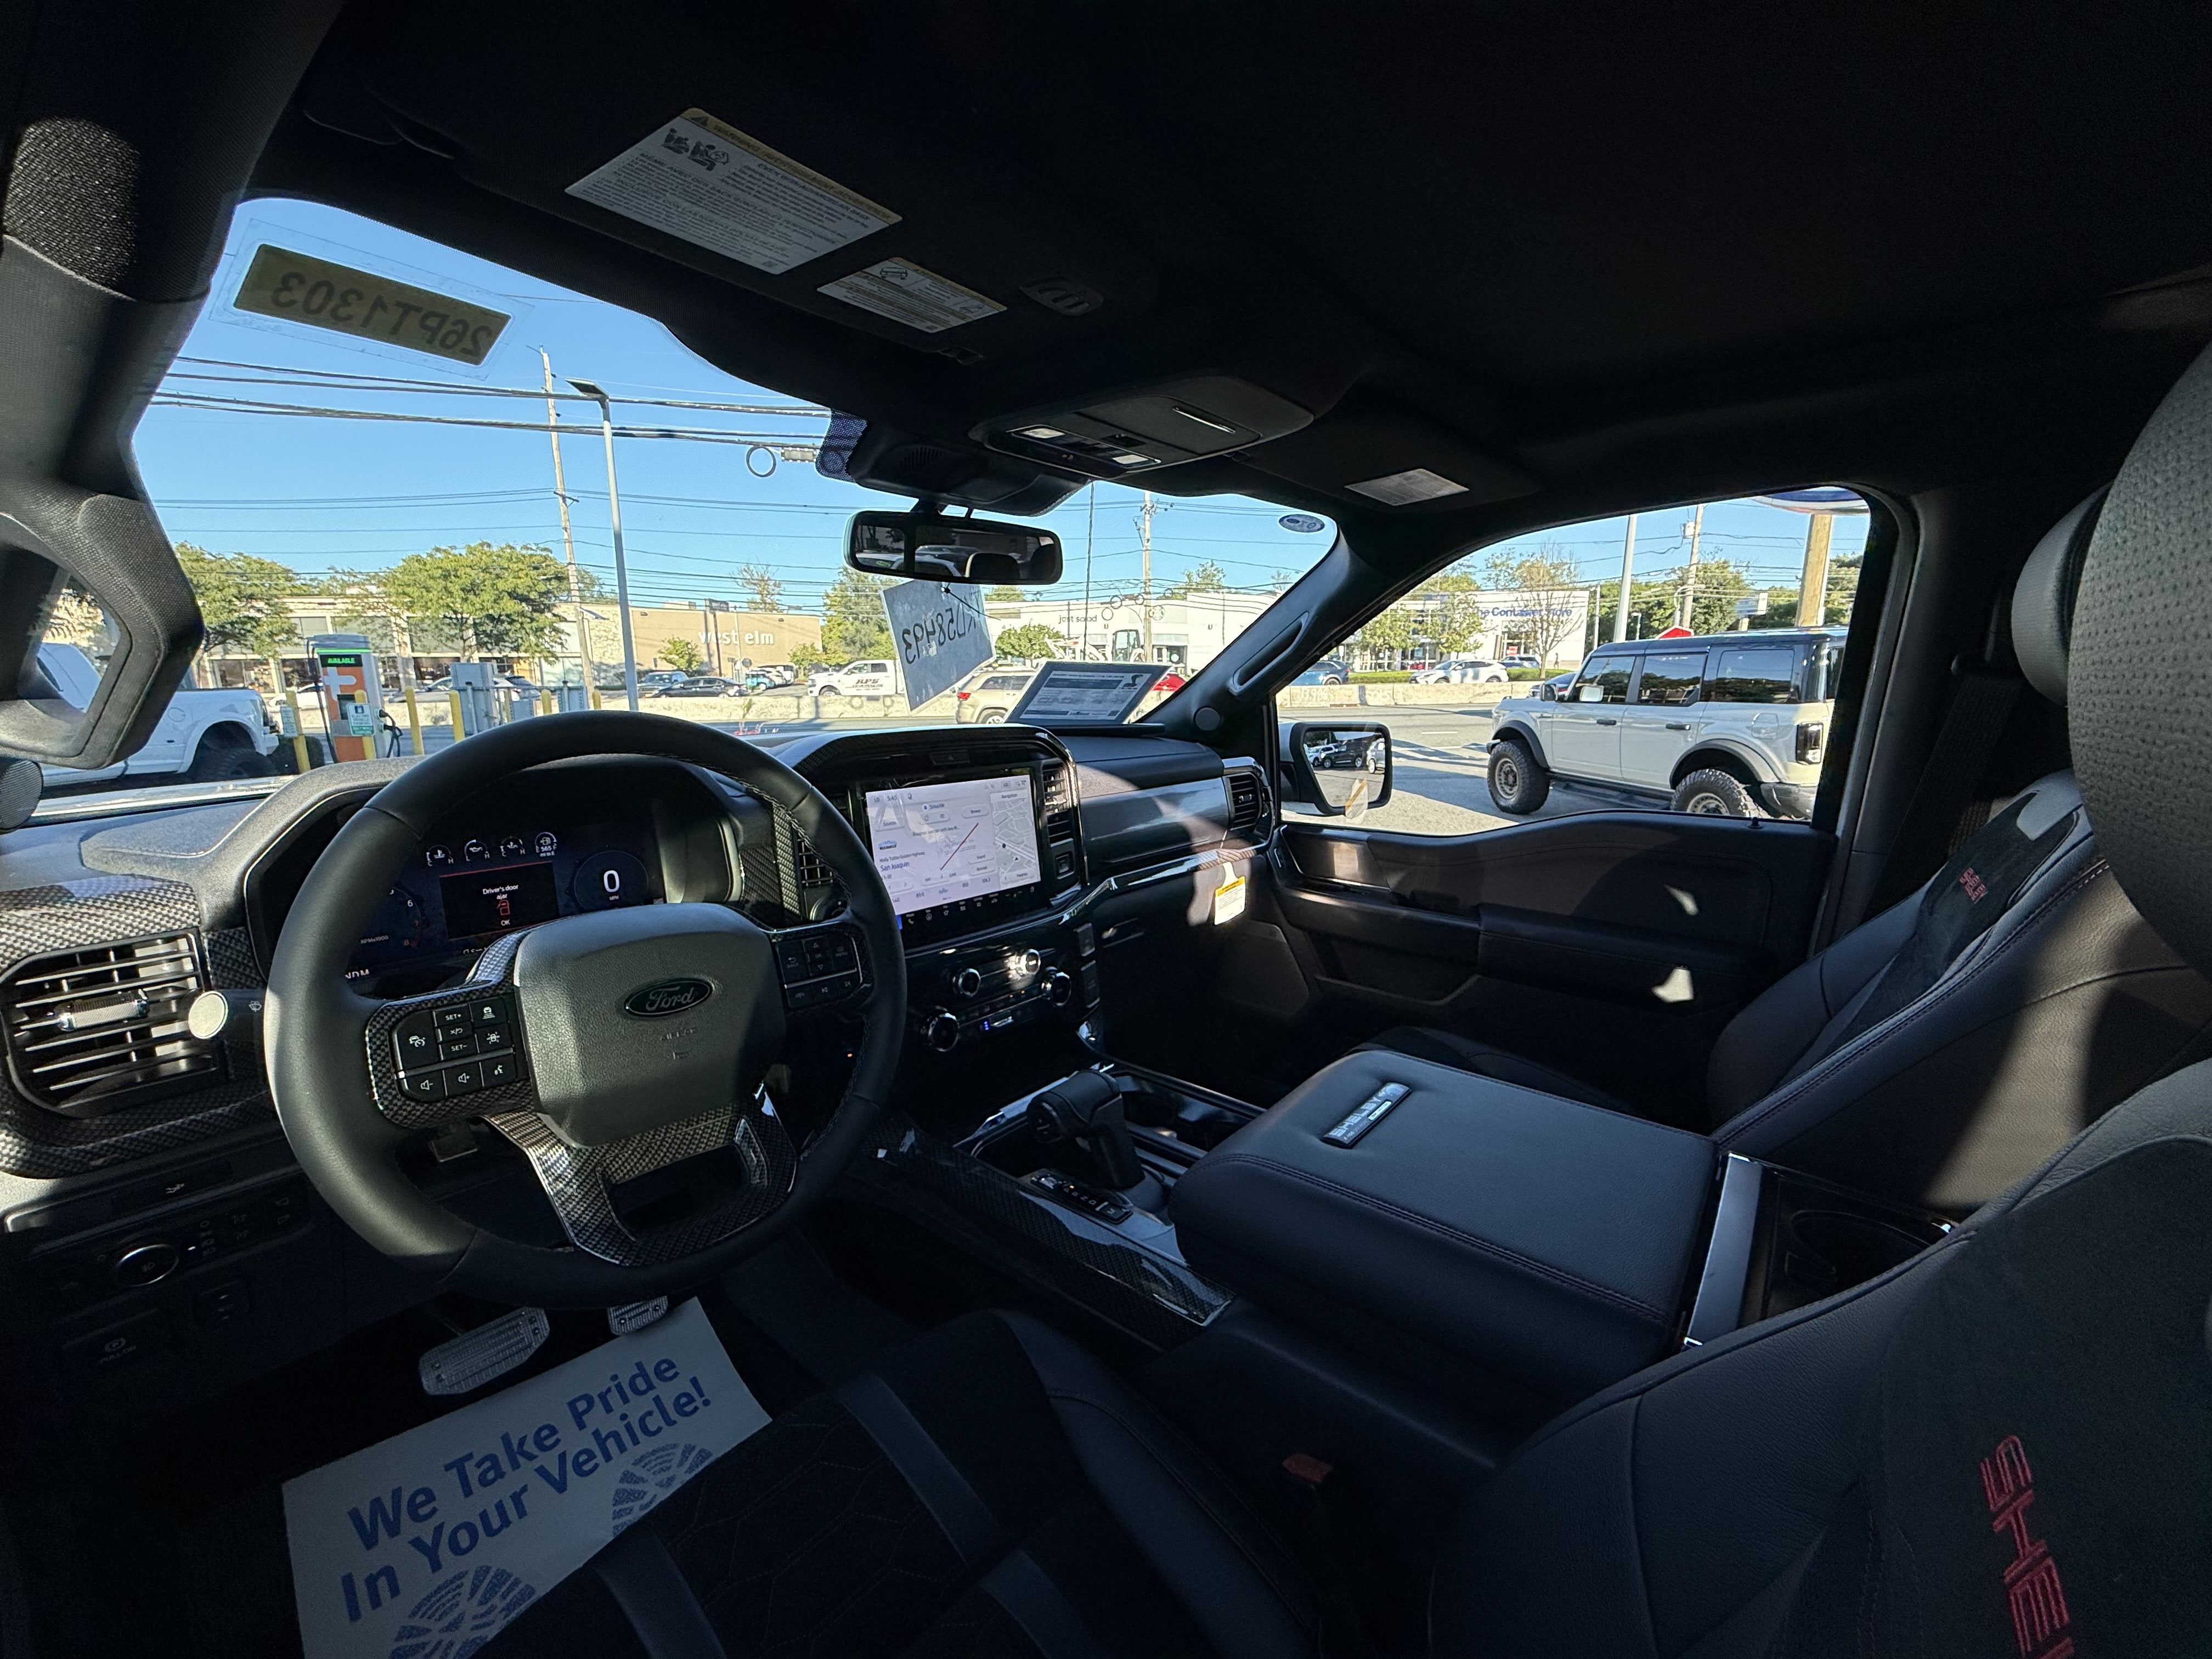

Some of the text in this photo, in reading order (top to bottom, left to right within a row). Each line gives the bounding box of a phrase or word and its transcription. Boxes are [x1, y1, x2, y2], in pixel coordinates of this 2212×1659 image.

[698, 629, 774, 645] west elm
[482, 885, 505, 895] Driver's
[603, 870, 620, 893] 0
[646, 986, 696, 1011] Ford
[347, 1357, 680, 1551] We Take Pride
[339, 1375, 713, 1623] In Your Vehicle!
